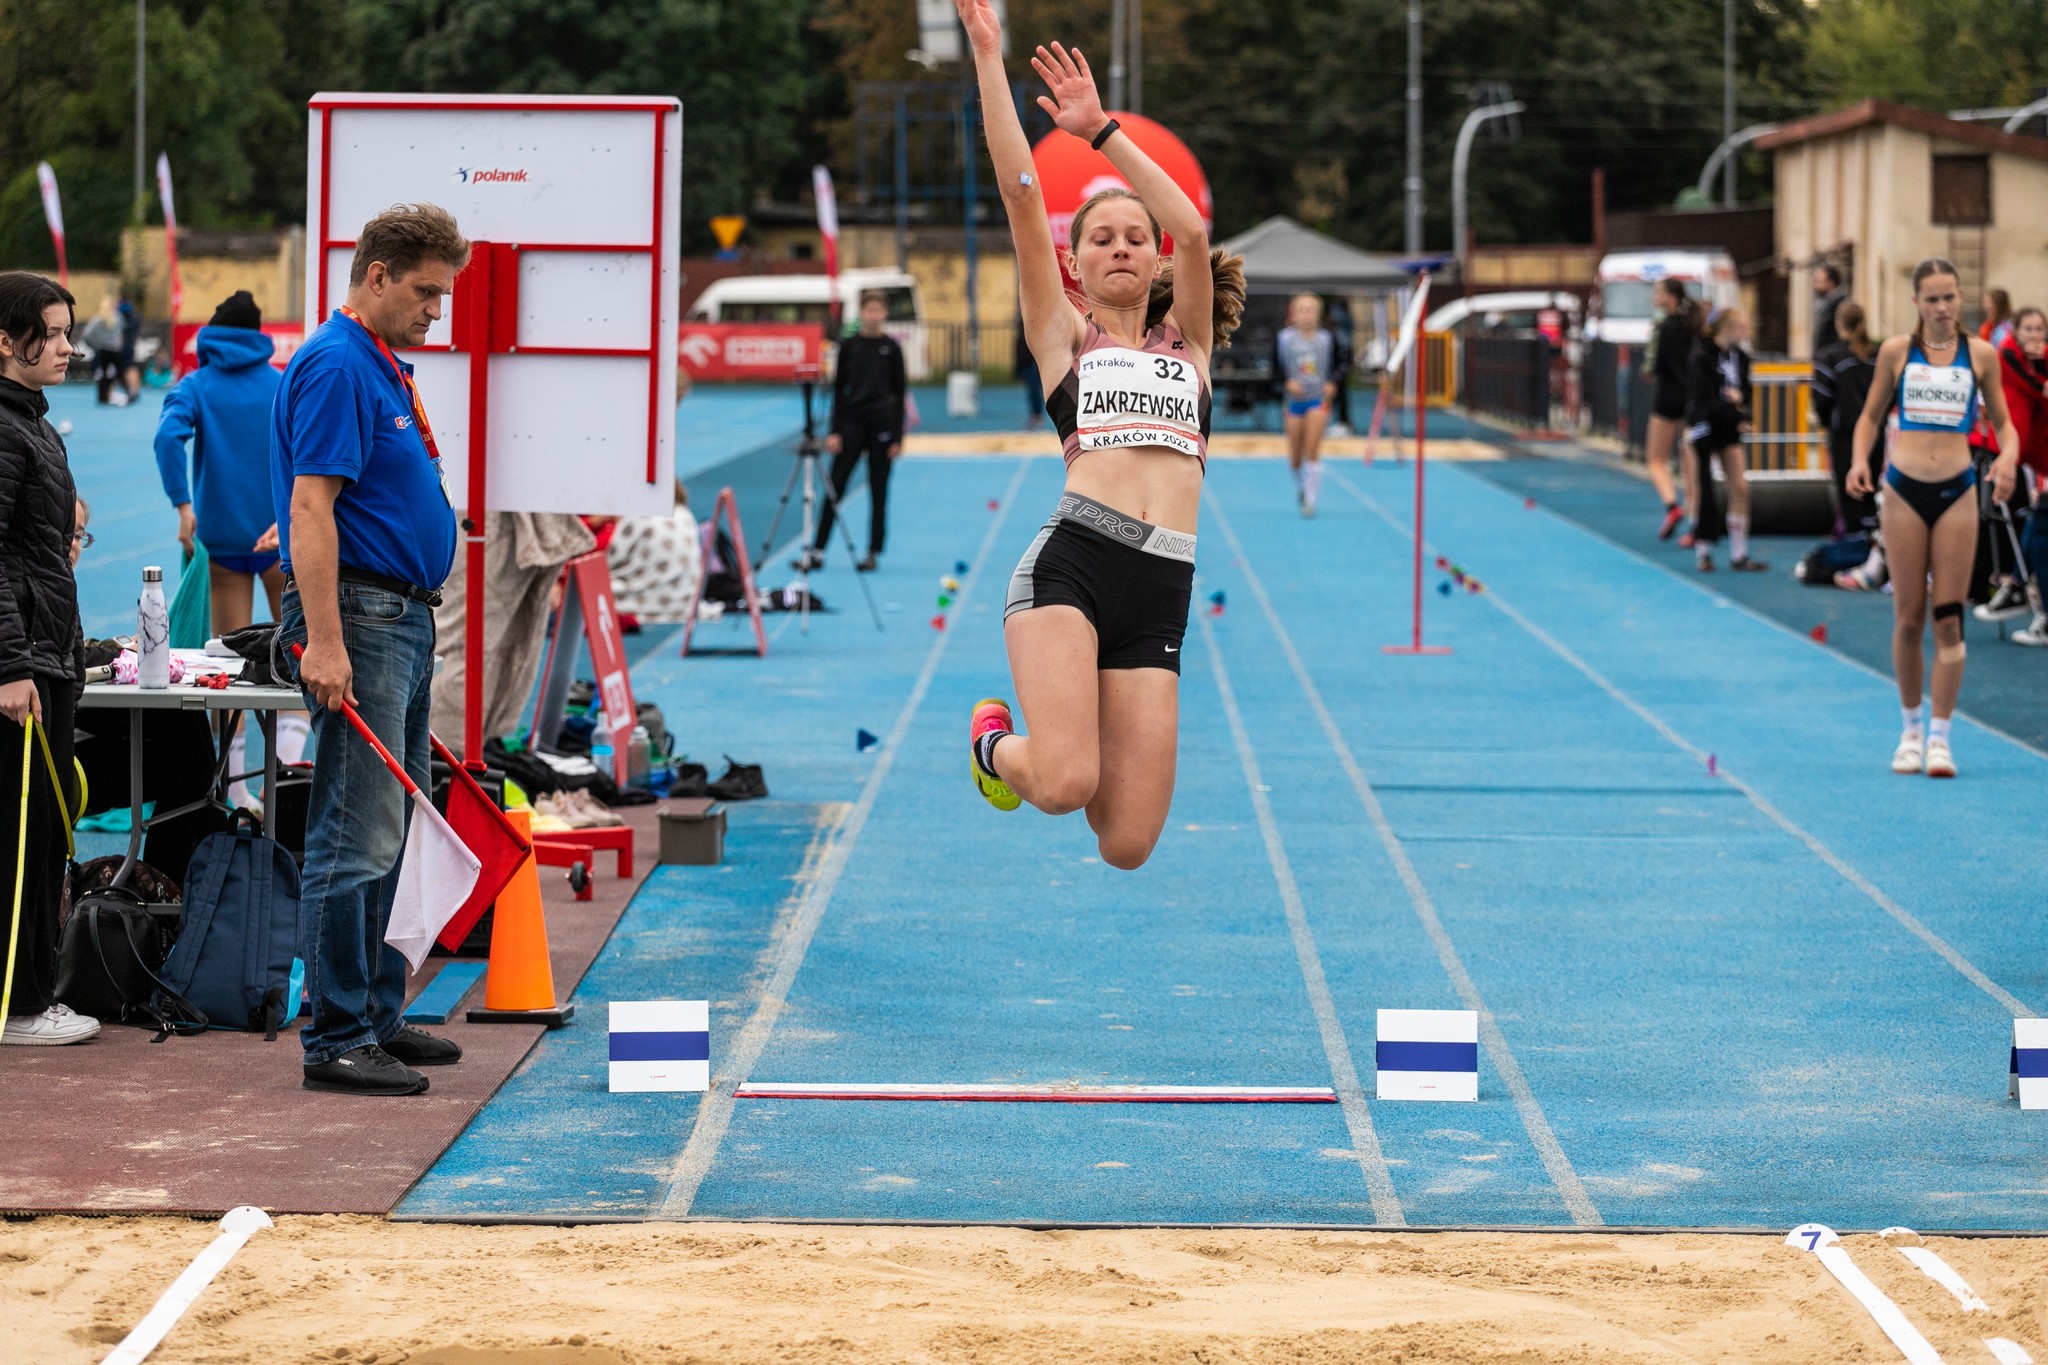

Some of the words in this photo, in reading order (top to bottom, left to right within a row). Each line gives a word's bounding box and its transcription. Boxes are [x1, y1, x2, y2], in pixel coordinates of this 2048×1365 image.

[472, 168, 528, 184] polanik
[1096, 357, 1135, 369] Kraków
[1153, 357, 1186, 382] 32
[1082, 390, 1196, 423] ZAKRZEWSKA
[1093, 430, 1157, 448] KRAKÓW
[1162, 433, 1190, 451] 2022
[1075, 502, 1143, 540] PRO
[1800, 1231, 1822, 1251] 7
